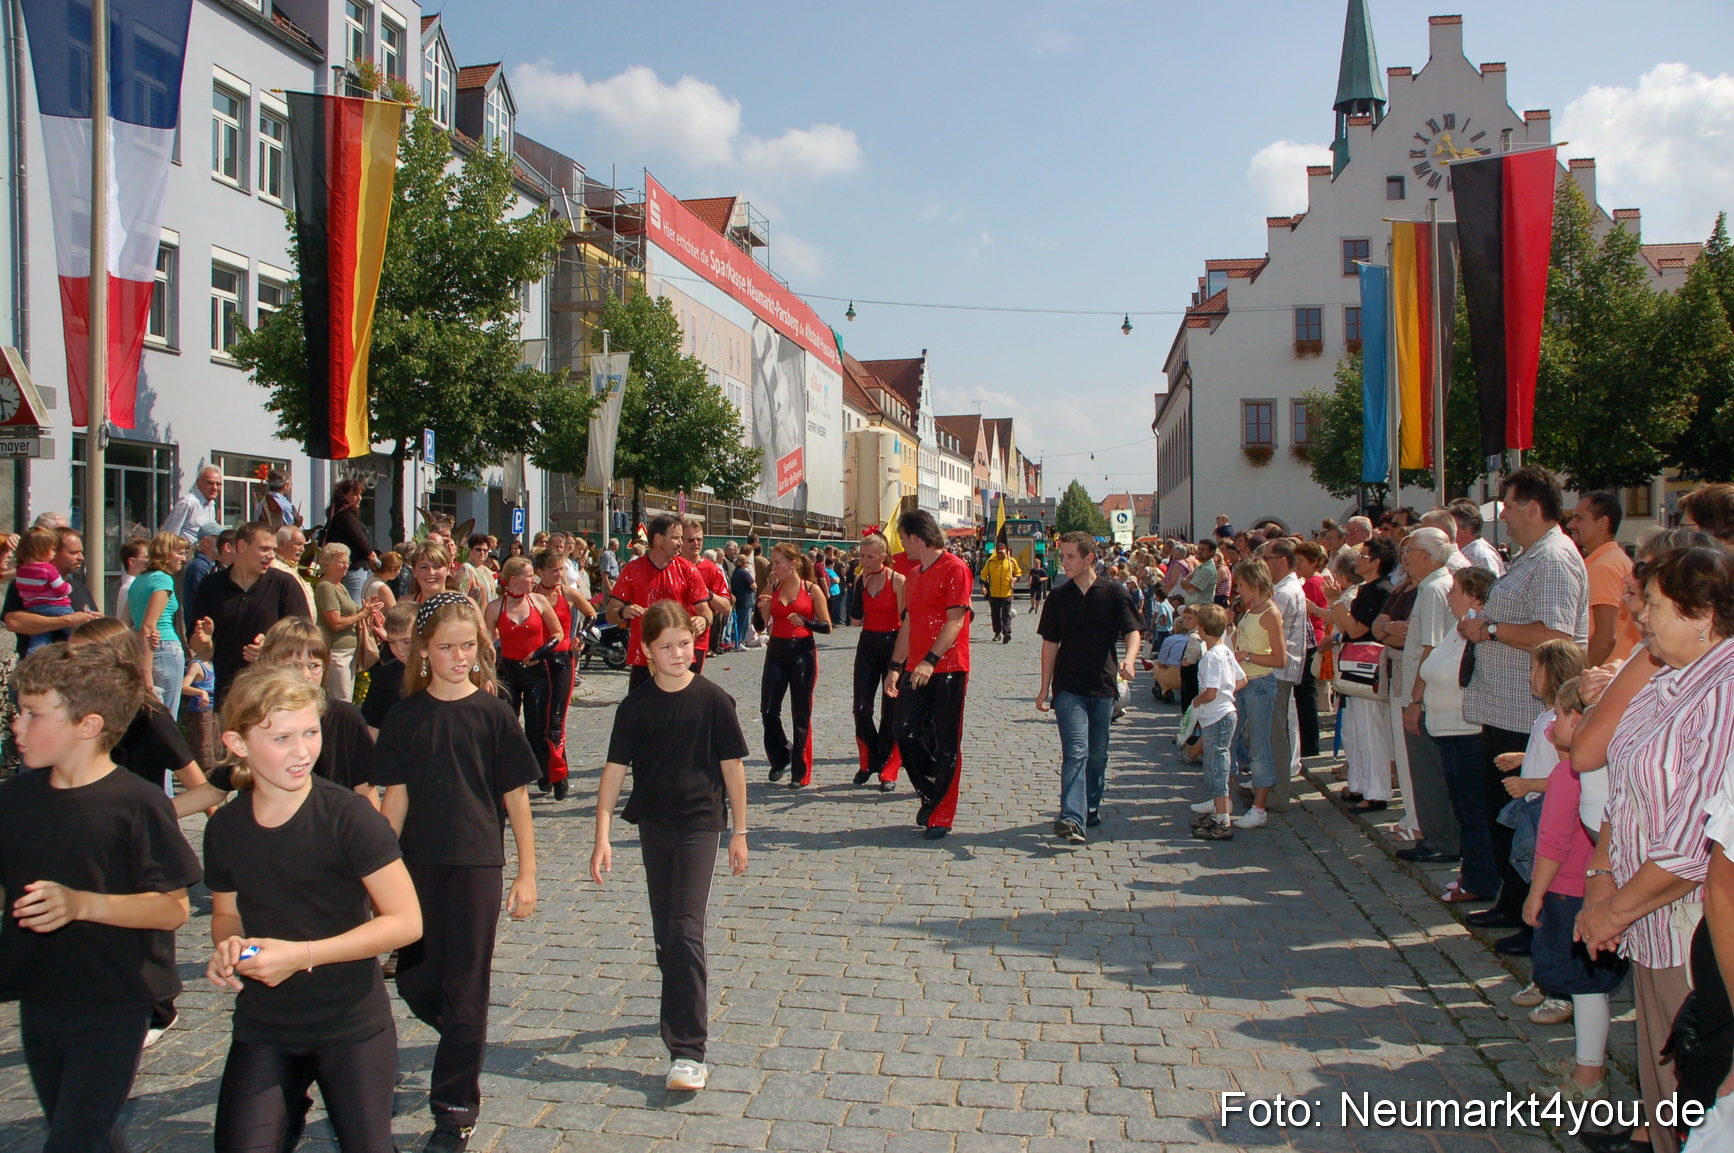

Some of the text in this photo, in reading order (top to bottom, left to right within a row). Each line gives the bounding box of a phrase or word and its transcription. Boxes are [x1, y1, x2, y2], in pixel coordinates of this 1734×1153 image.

[662, 219, 676, 242] Hier
[676, 234, 701, 261] errichtet
[709, 249, 746, 293] Sparkasse
[515, 511, 523, 531] P
